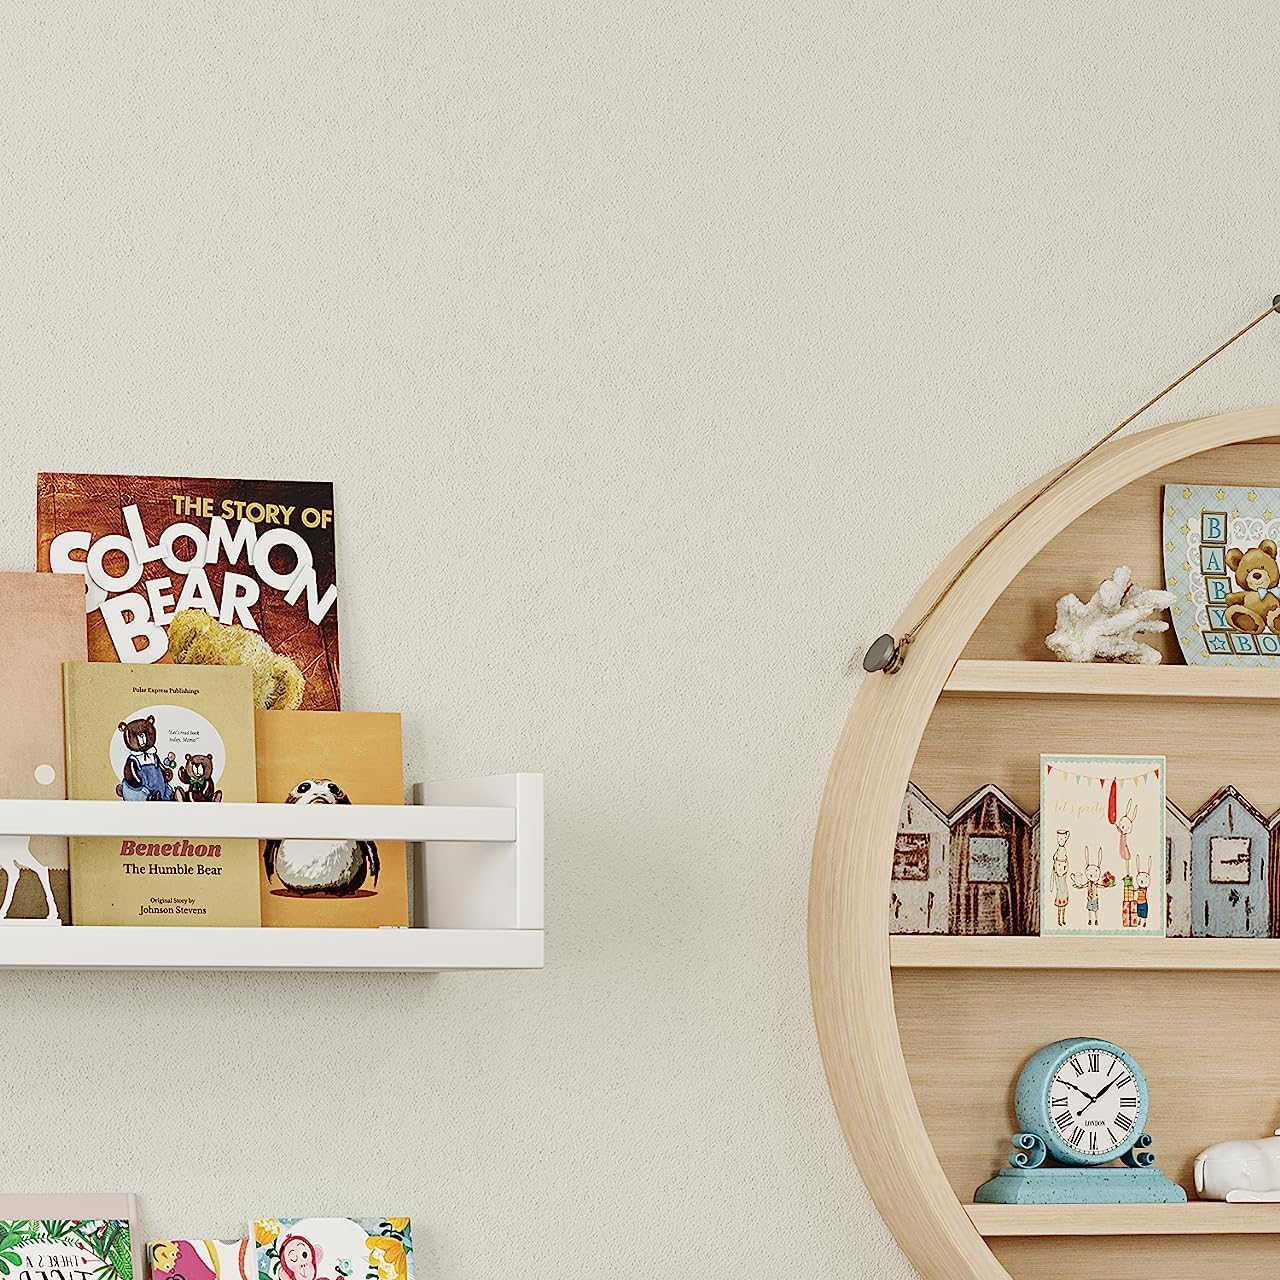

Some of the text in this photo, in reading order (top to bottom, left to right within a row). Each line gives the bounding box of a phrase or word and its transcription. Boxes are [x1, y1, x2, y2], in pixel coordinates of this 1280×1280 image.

[172, 495, 333, 529] THE STORY OF
[49, 504, 338, 626] SOLOMON
[100, 567, 260, 665] BEAR
[120, 840, 222, 857] Benethon
[123, 863, 223, 876] The Humble Bear
[139, 906, 207, 916] Johnson Stevens
